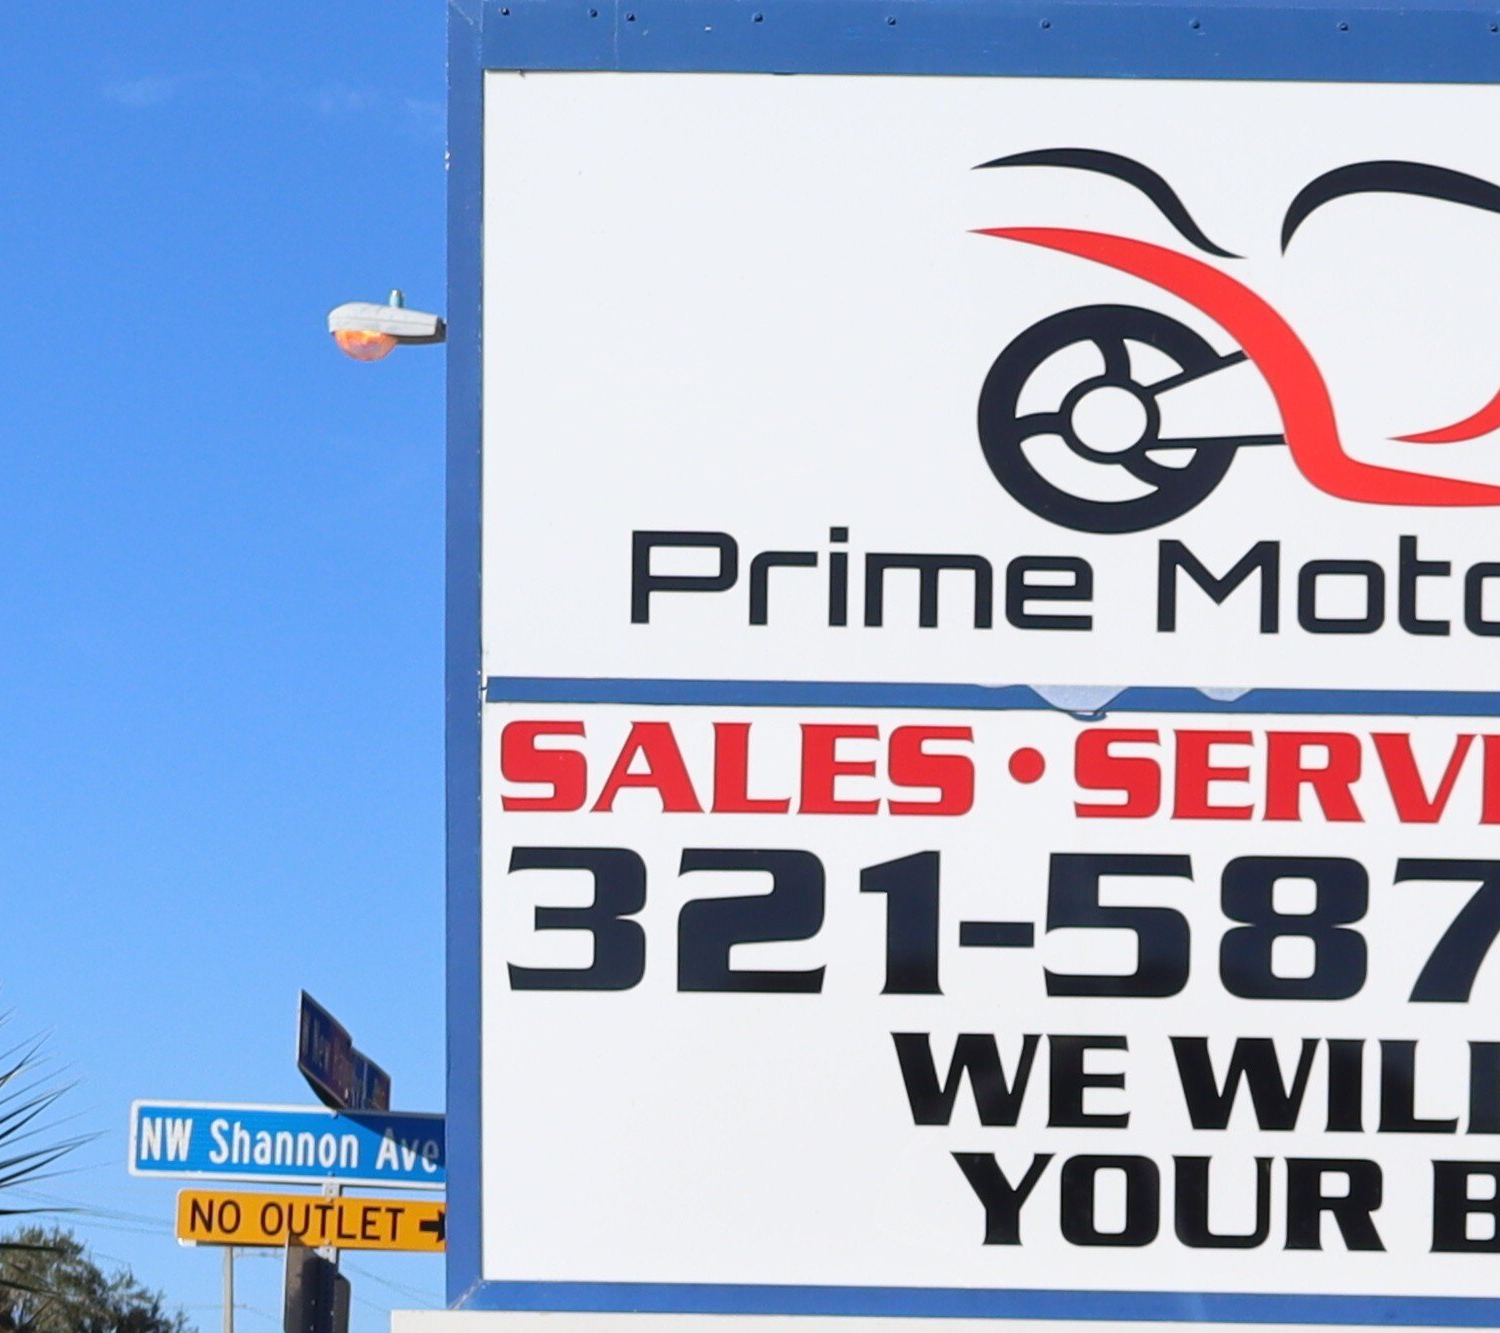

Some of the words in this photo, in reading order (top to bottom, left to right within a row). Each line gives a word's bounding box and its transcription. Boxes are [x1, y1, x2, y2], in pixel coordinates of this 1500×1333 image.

[631, 526, 1094, 631] Prime
[501, 720, 975, 816] SALES
[890, 1032, 1130, 1129] WE
[141, 1117, 193, 1161] NW
[209, 1119, 359, 1168] Shannon
[375, 1128, 439, 1174] Ave
[190, 1199, 241, 1234] NO
[260, 1202, 405, 1241] OUTLET
[951, 1152, 1386, 1252] YOUR
